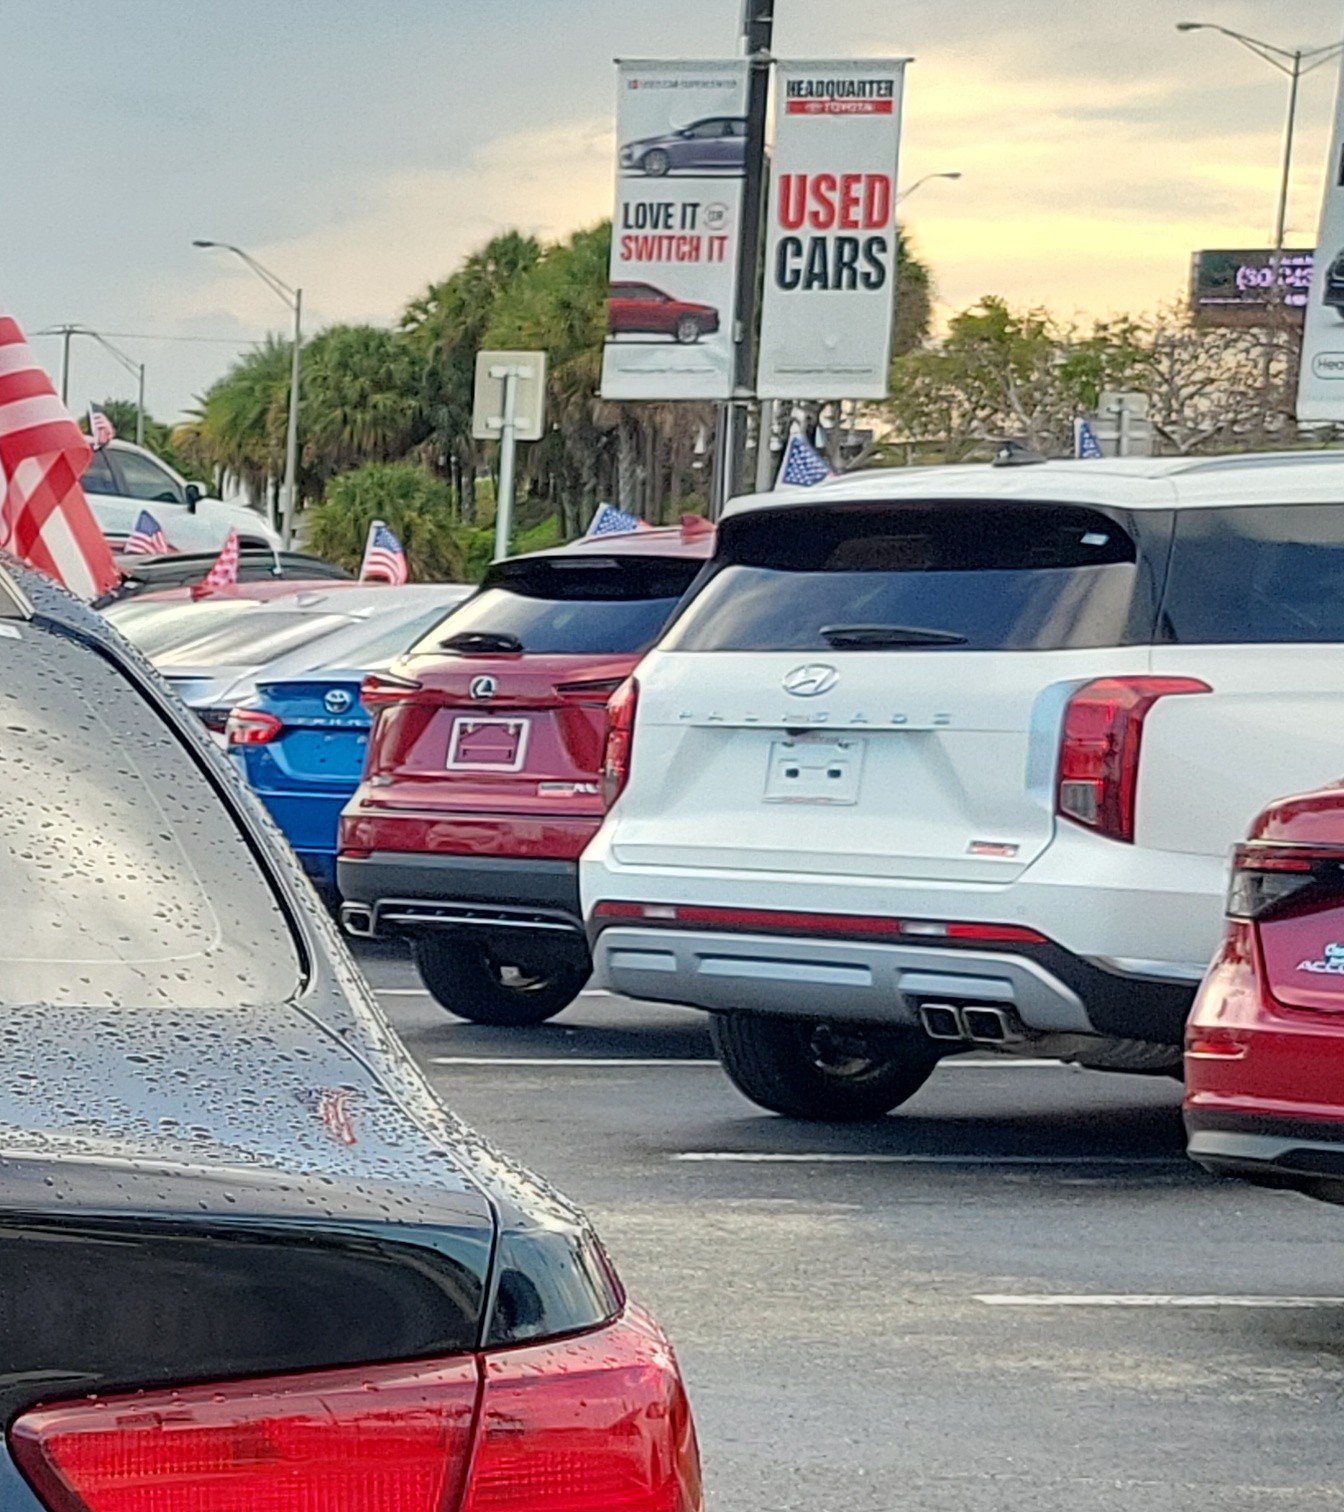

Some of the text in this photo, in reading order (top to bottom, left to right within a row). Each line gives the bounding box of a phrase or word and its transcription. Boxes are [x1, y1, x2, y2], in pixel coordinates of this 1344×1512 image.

[786, 80, 894, 99] HEADQUARTER
[622, 202, 701, 230] LOVE IT
[778, 173, 891, 231] USED
[620, 235, 728, 262] SWITCH IT
[774, 235, 888, 291] CARS
